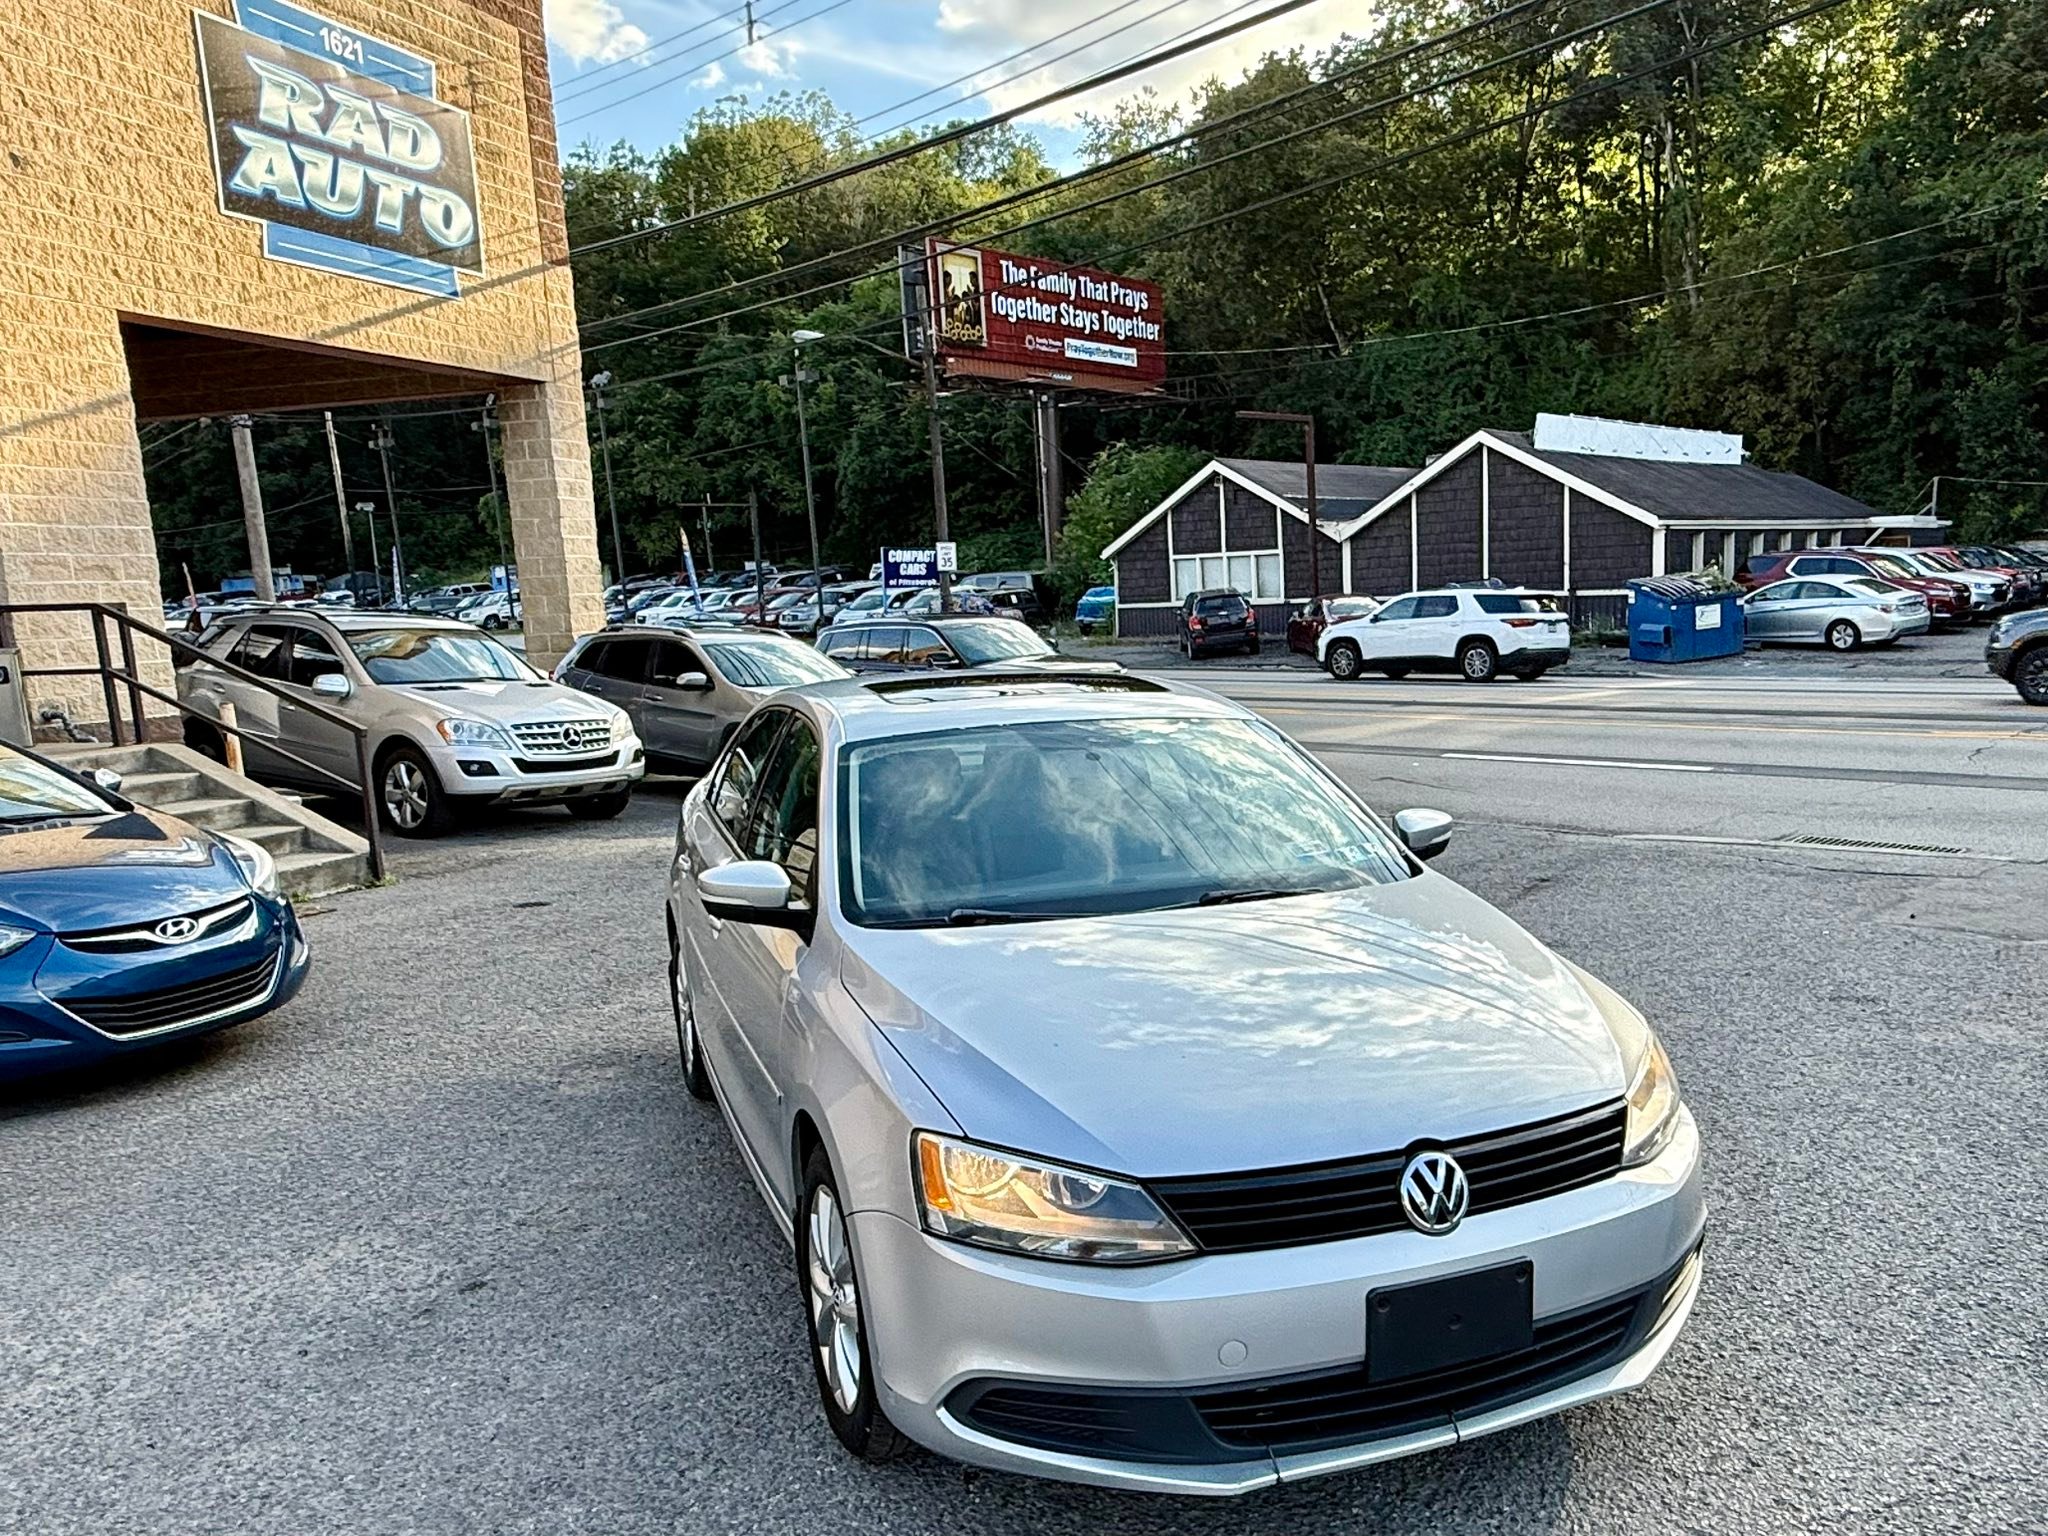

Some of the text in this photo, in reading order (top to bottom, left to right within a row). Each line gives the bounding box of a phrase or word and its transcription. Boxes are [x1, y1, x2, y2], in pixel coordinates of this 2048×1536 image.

[319, 27, 365, 64] 1621
[245, 55, 442, 171] RAD
[229, 125, 475, 248] AUTO
[1000, 259, 1149, 313] The Family That Prays
[991, 291, 1160, 341] Together Stays Together
[888, 549, 936, 563] COMPACT
[899, 563, 927, 576] CARS
[941, 557, 953, 568] 35
